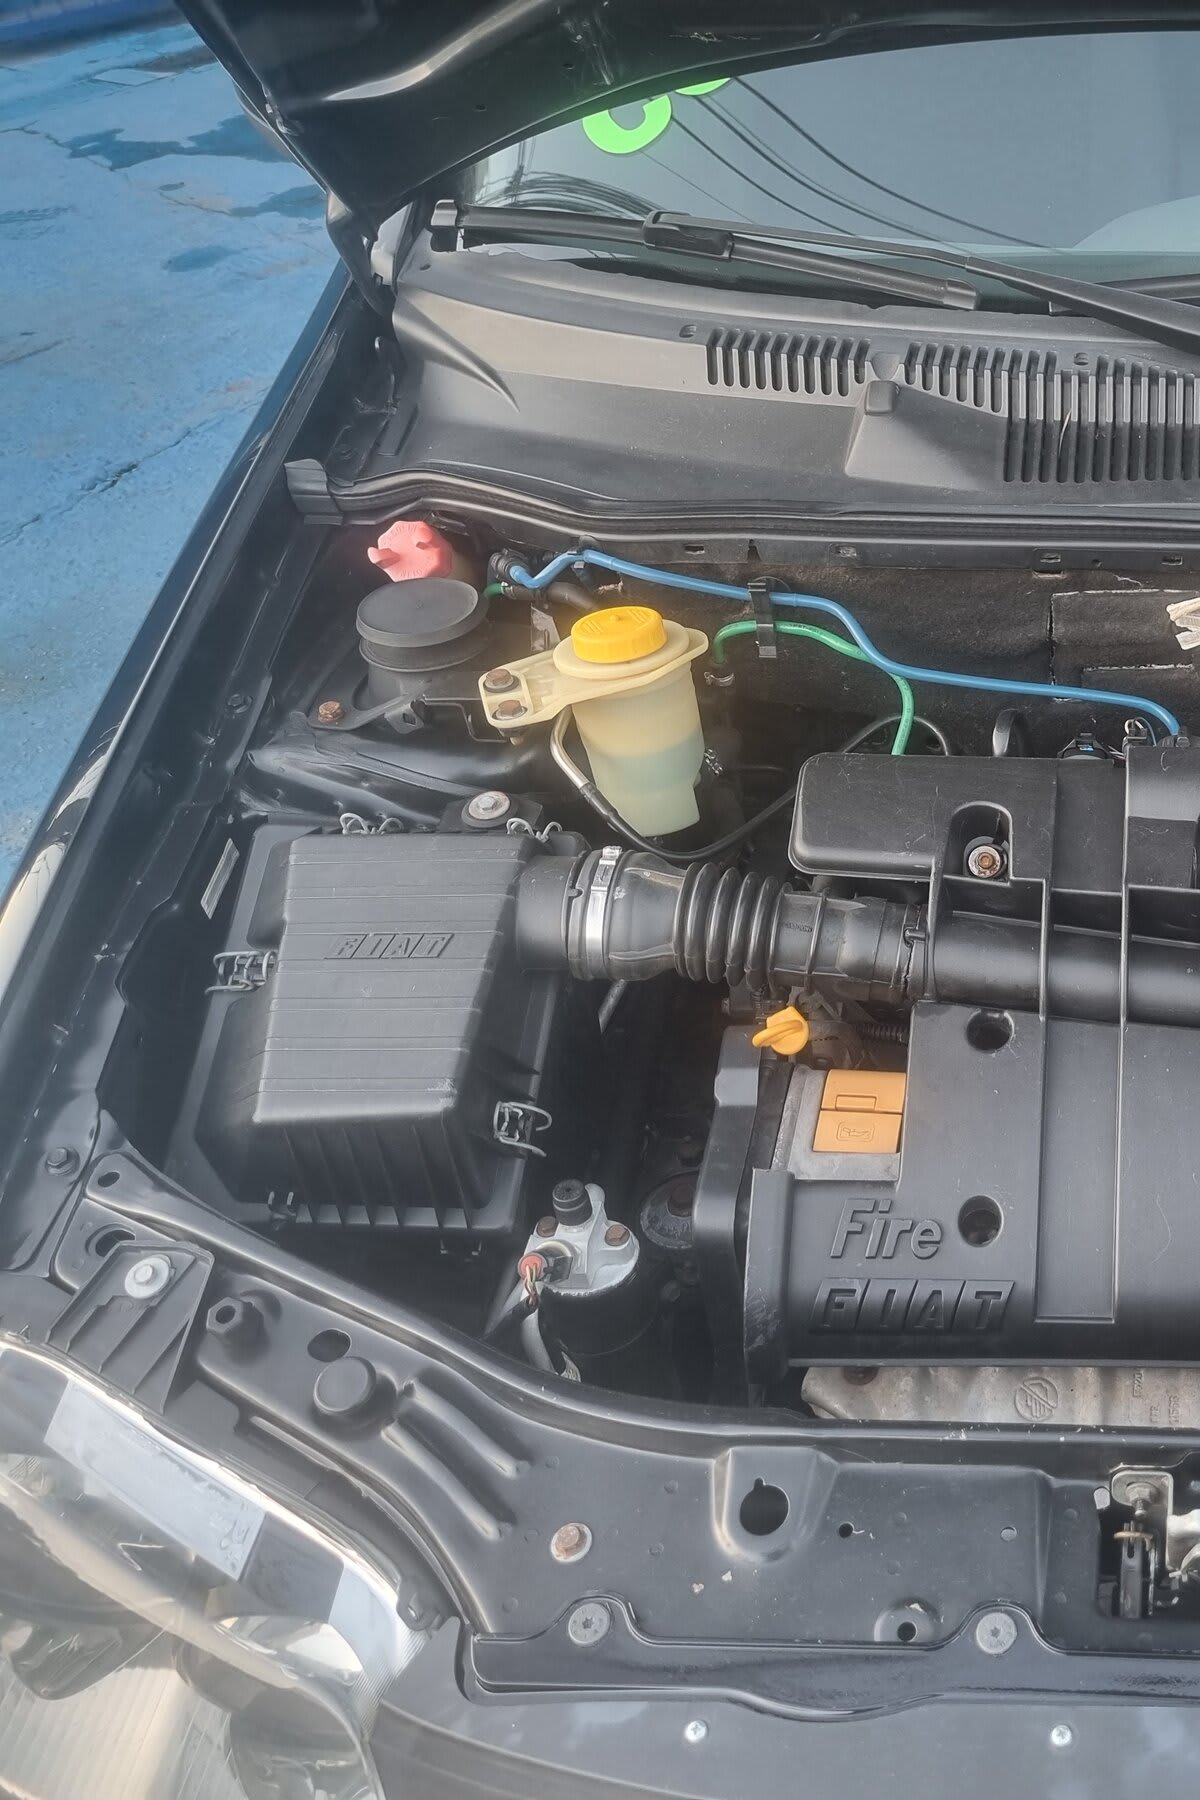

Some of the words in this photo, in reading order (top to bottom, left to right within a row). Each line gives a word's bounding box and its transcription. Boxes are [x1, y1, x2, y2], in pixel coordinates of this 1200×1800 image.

[330, 934, 450, 958] FIAT
[830, 1198, 942, 1260] Fire
[813, 1281, 1011, 1332] FIAT
